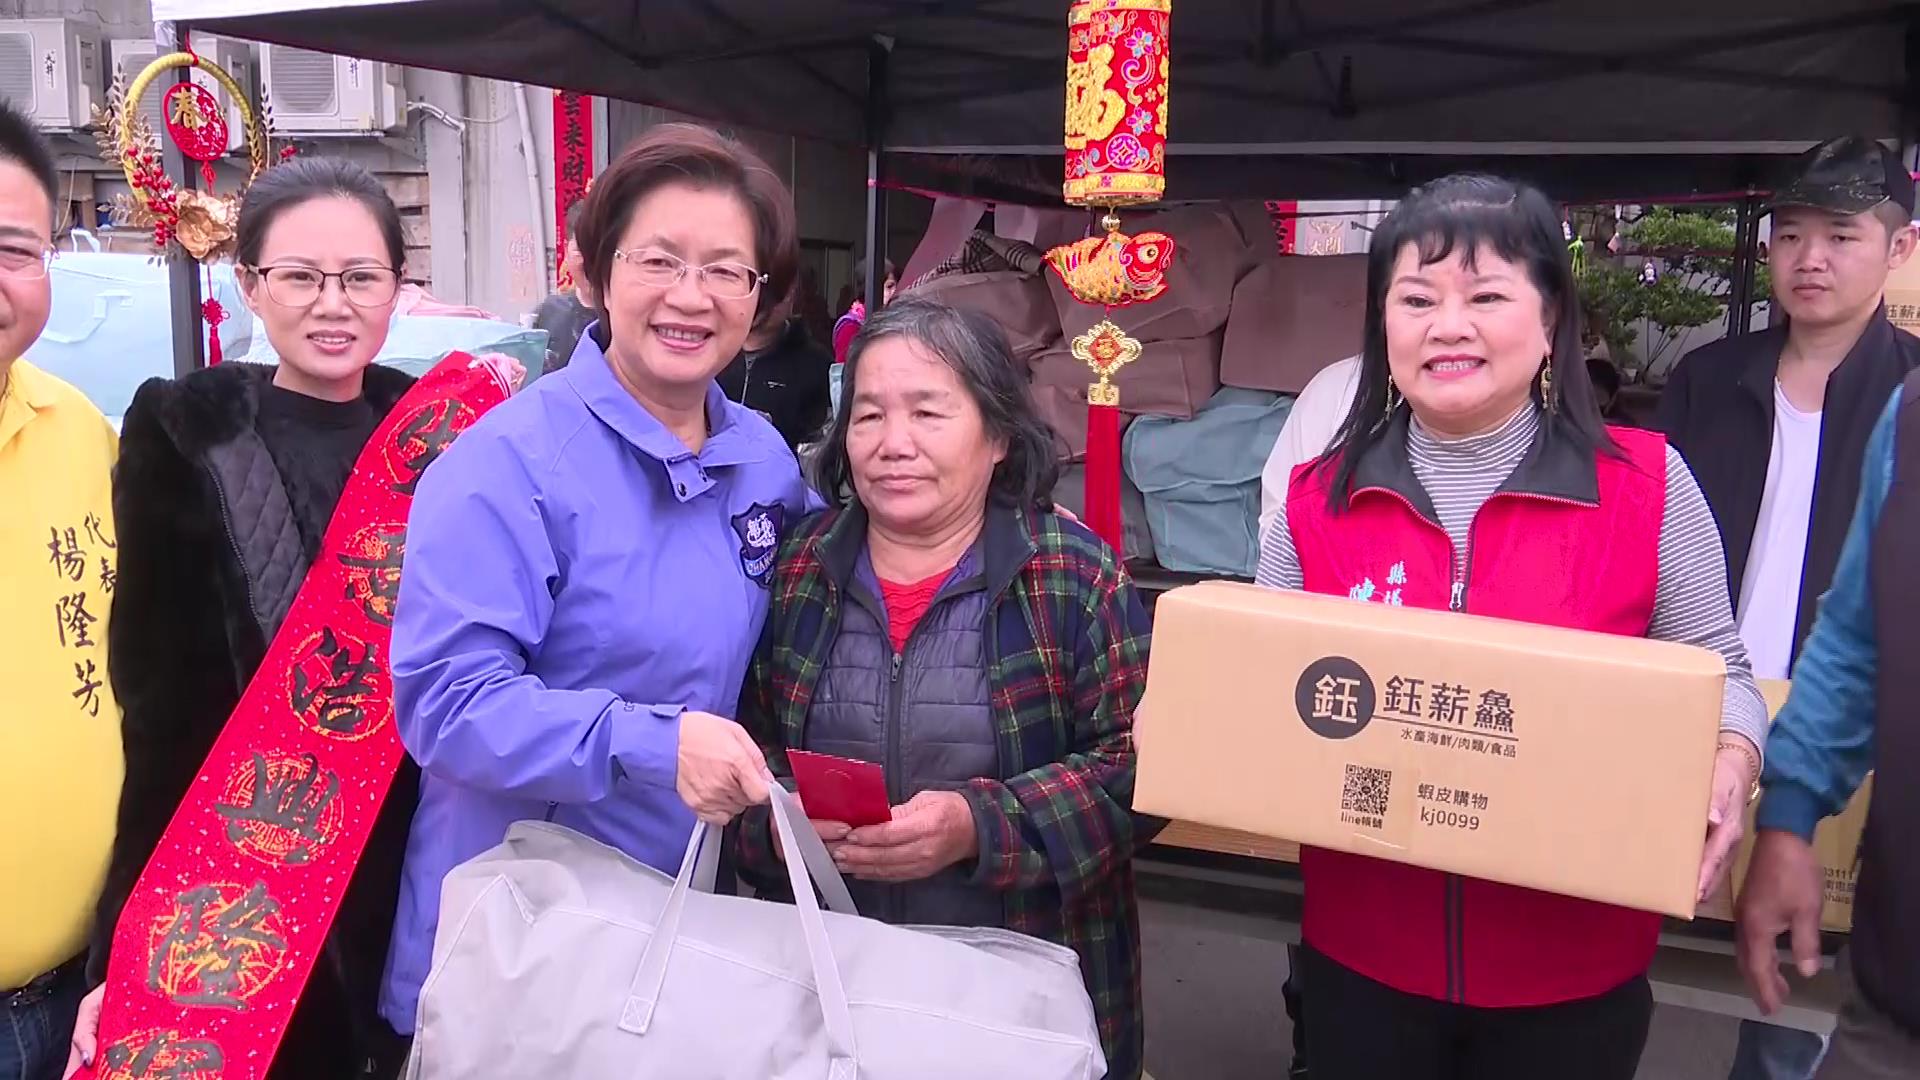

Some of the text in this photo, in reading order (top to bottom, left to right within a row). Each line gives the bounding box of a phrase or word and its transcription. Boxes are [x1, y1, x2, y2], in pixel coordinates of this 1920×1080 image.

[170, 86, 209, 131] 春
[83, 511, 118, 594] 代表
[47, 526, 103, 718] 楊隆芳
[1311, 673, 1361, 724] 鈺
[1416, 783, 1489, 811] 蝦皮購物
[1420, 806, 1480, 830] kj0099
